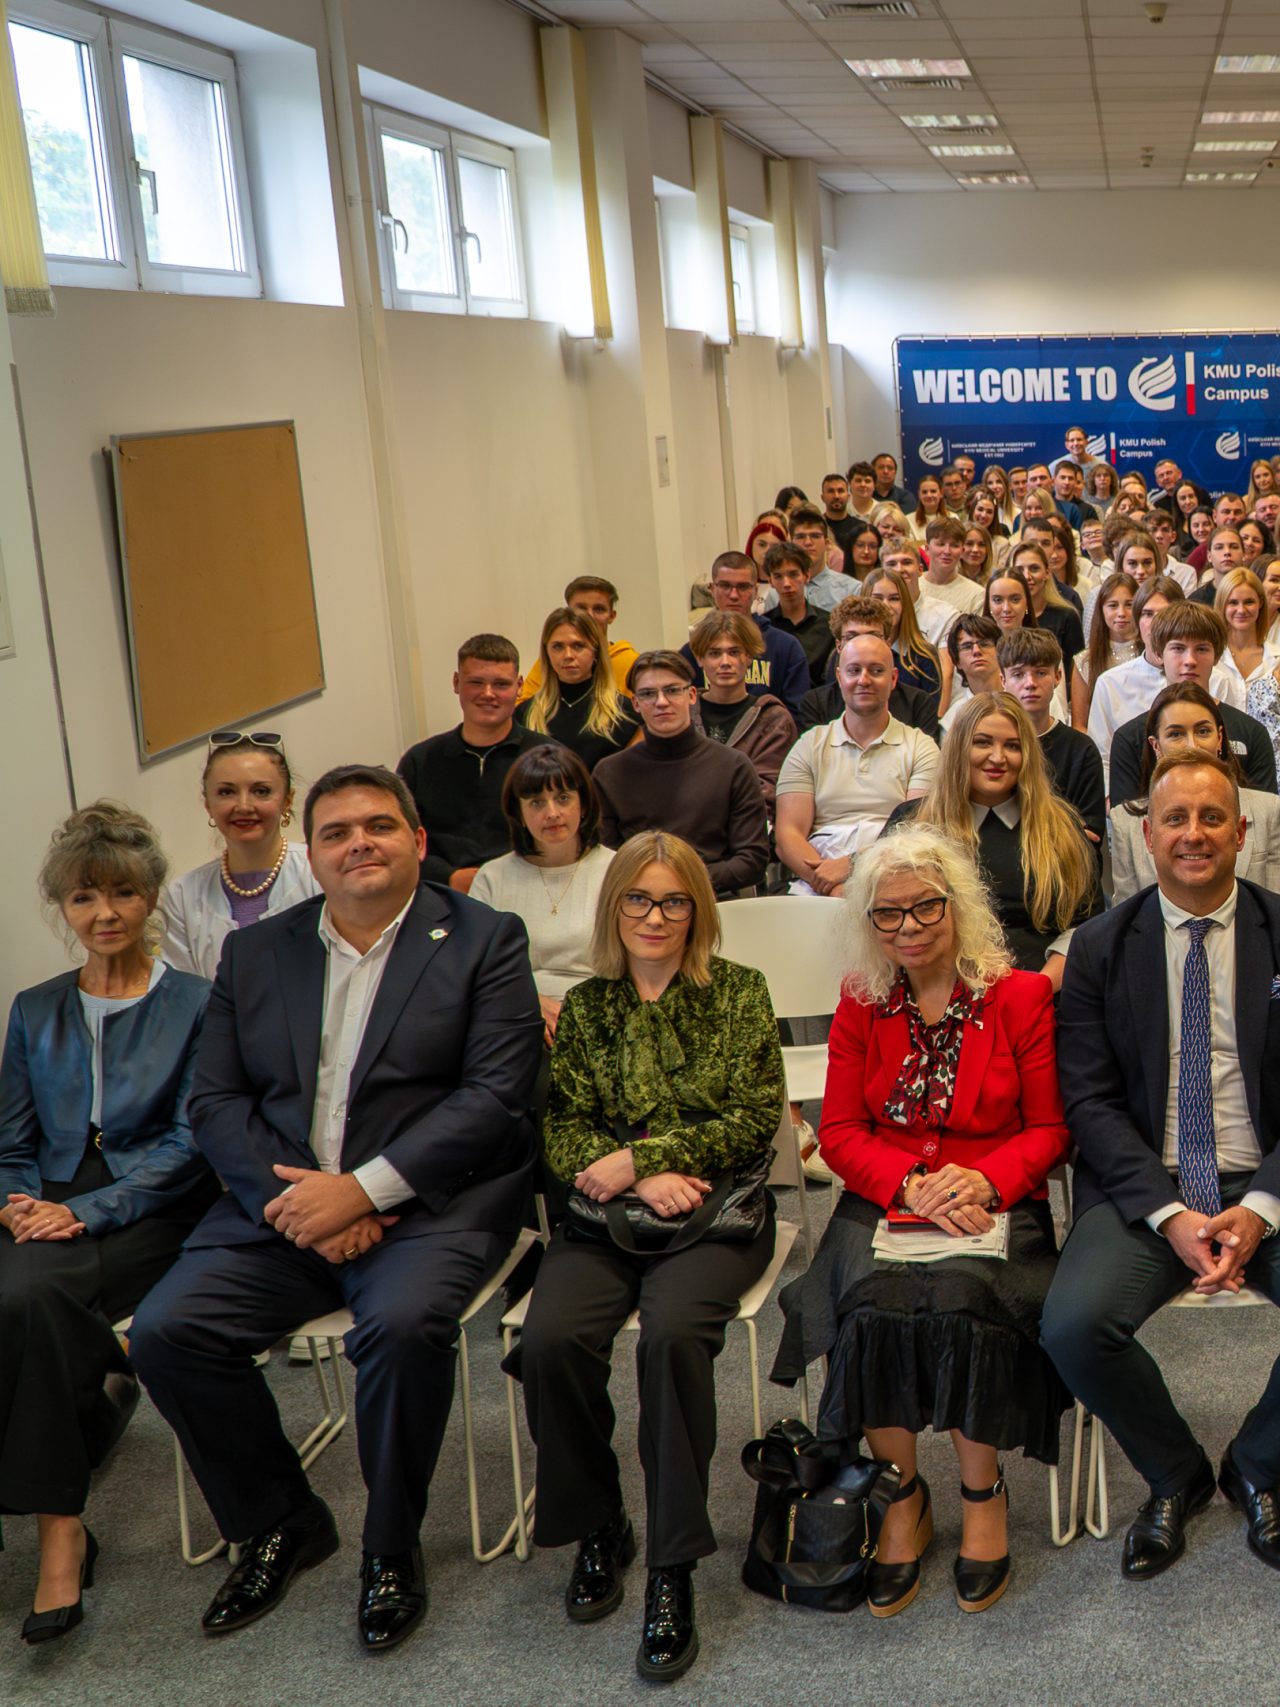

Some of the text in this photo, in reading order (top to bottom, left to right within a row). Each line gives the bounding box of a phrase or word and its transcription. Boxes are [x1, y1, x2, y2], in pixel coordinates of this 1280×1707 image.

[1203, 364, 1242, 379] KMU
[911, 366, 1118, 404] WELCOME TO
[1203, 386, 1270, 404] Campus
